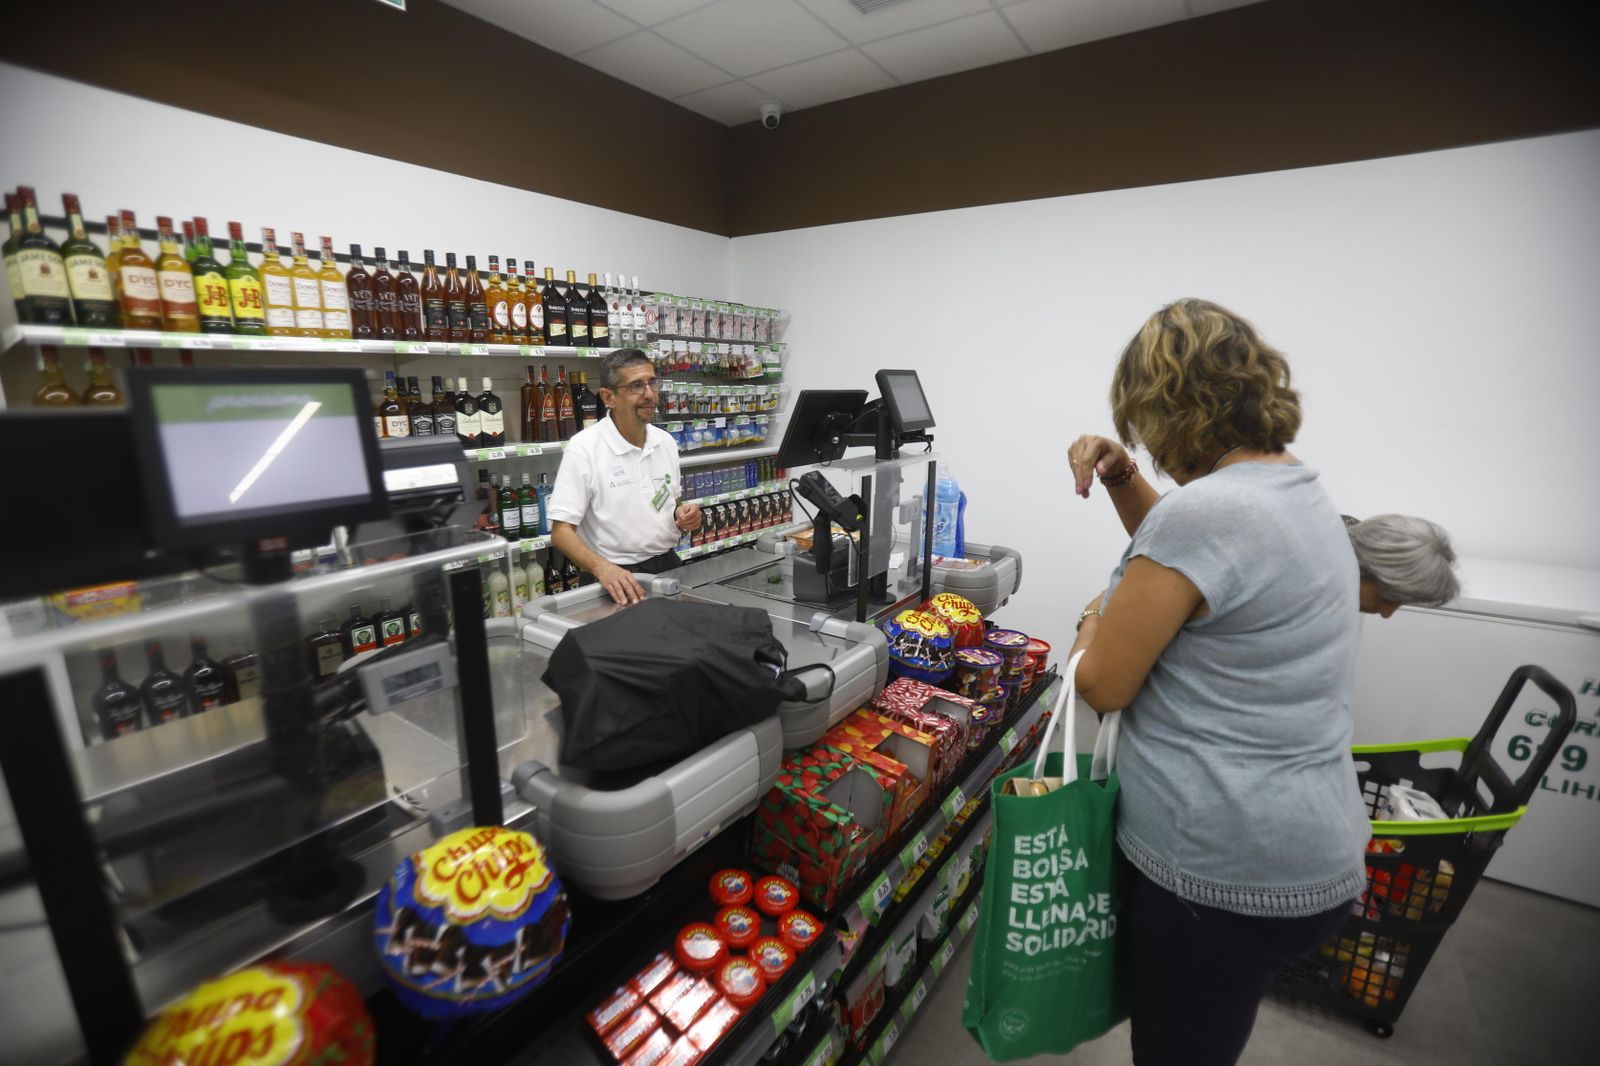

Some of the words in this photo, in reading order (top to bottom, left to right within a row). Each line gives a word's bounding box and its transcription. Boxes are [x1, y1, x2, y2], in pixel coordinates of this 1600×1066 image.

[129, 274, 156, 286] DYC
[164, 278, 191, 289] DYC
[433, 826, 506, 883] Chupa
[455, 835, 534, 903] Chups
[877, 882, 889, 898] 0,25
[1011, 872, 1069, 904] ESTÁ
[1008, 901, 1087, 931] LLENA
